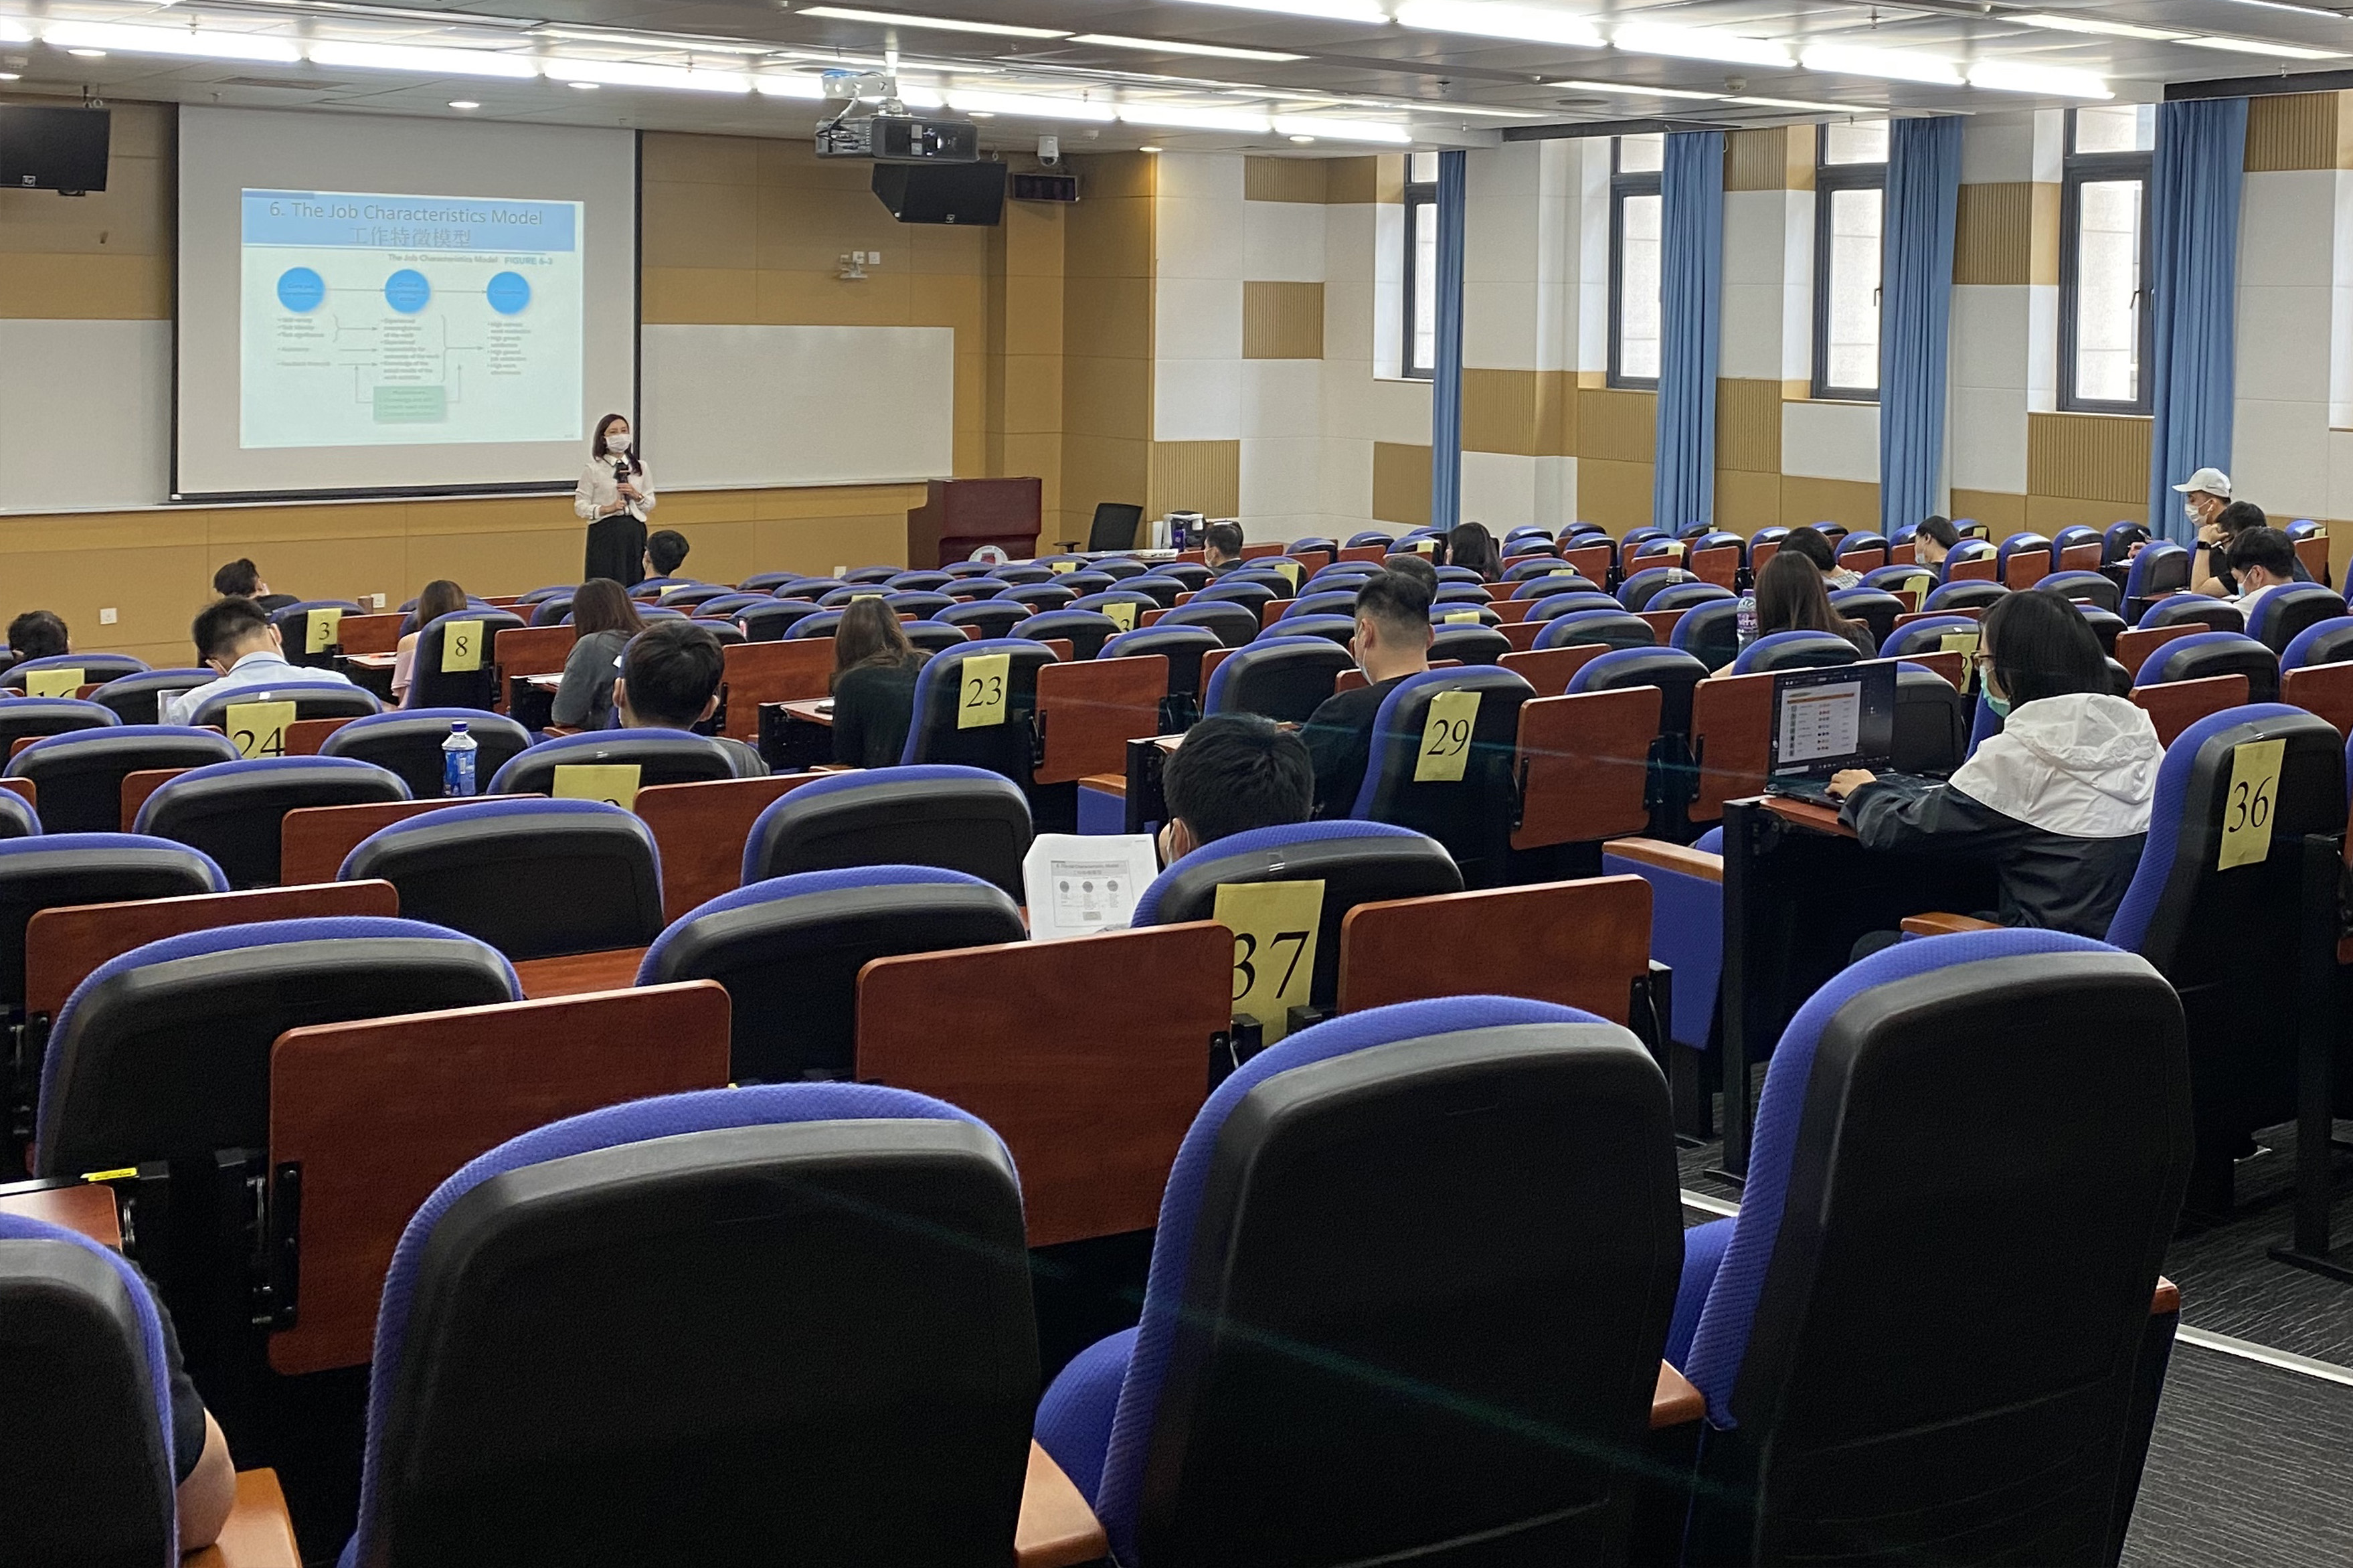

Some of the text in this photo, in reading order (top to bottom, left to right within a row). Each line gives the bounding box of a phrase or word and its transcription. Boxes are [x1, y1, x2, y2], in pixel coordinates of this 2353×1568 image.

[270, 201, 542, 225] 6. The Job Characteristics Model
[505, 256, 535, 265] FIGURE
[318, 622, 330, 640] 3
[455, 636, 468, 657] 8
[966, 676, 1002, 707] 23
[234, 727, 285, 758] 24
[1426, 719, 1469, 756] 29
[2228, 776, 2273, 833] 36
[1233, 931, 1310, 1001] 37
